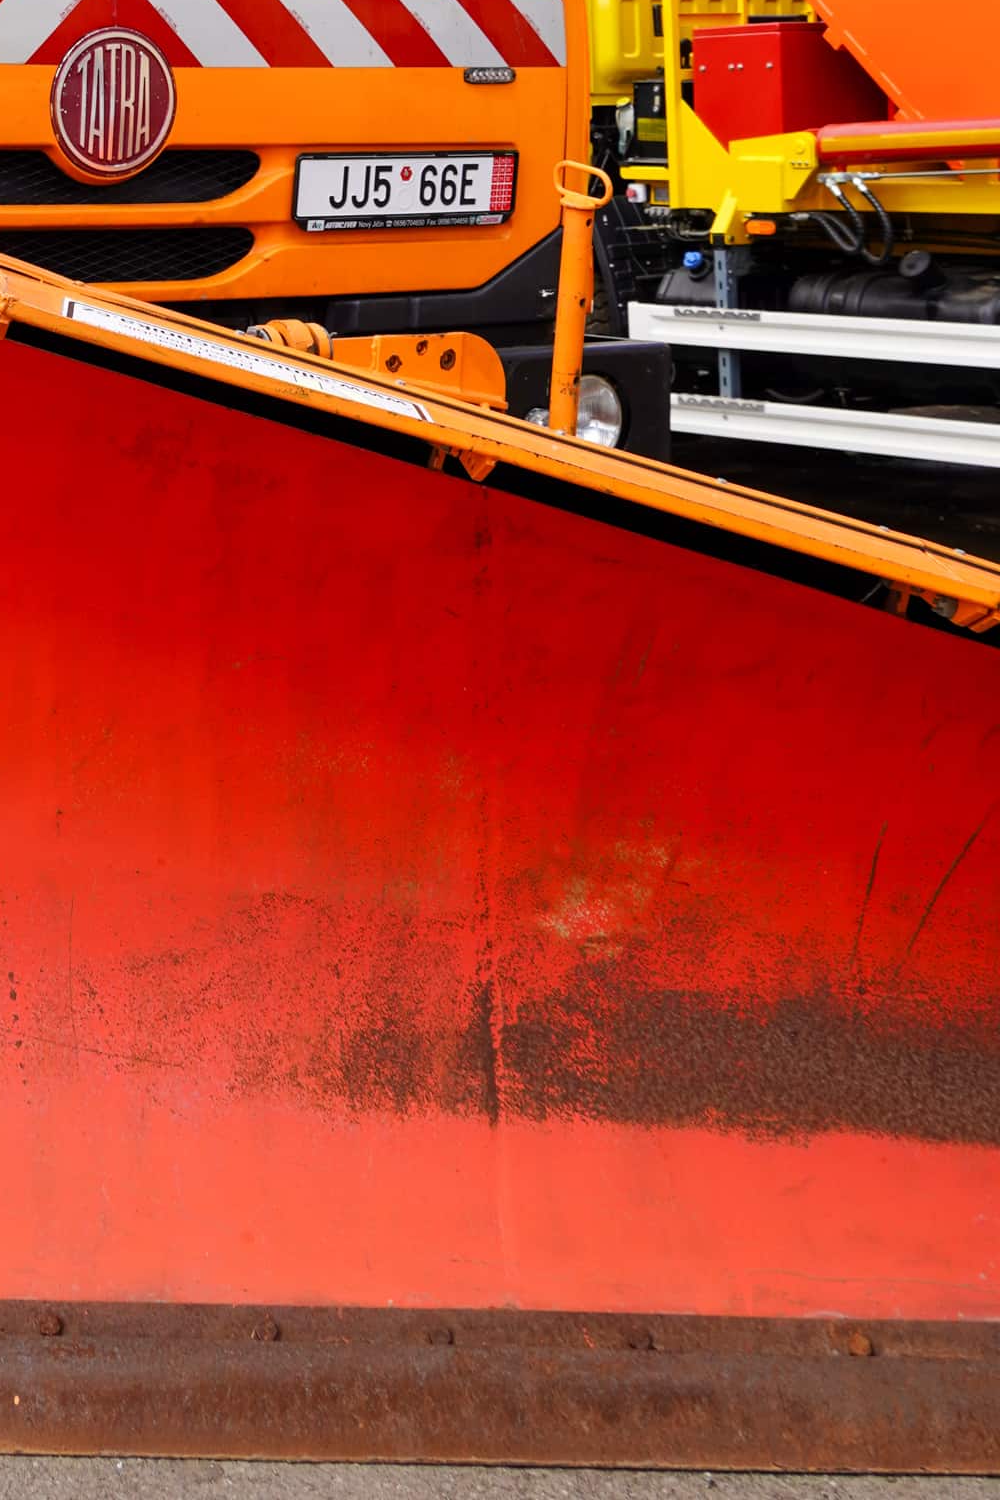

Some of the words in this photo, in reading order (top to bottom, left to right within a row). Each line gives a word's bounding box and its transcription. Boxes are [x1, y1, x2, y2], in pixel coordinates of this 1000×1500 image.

[77, 43, 151, 161] TATRA
[329, 165, 393, 209] JJ5
[419, 164, 479, 206] 66E
